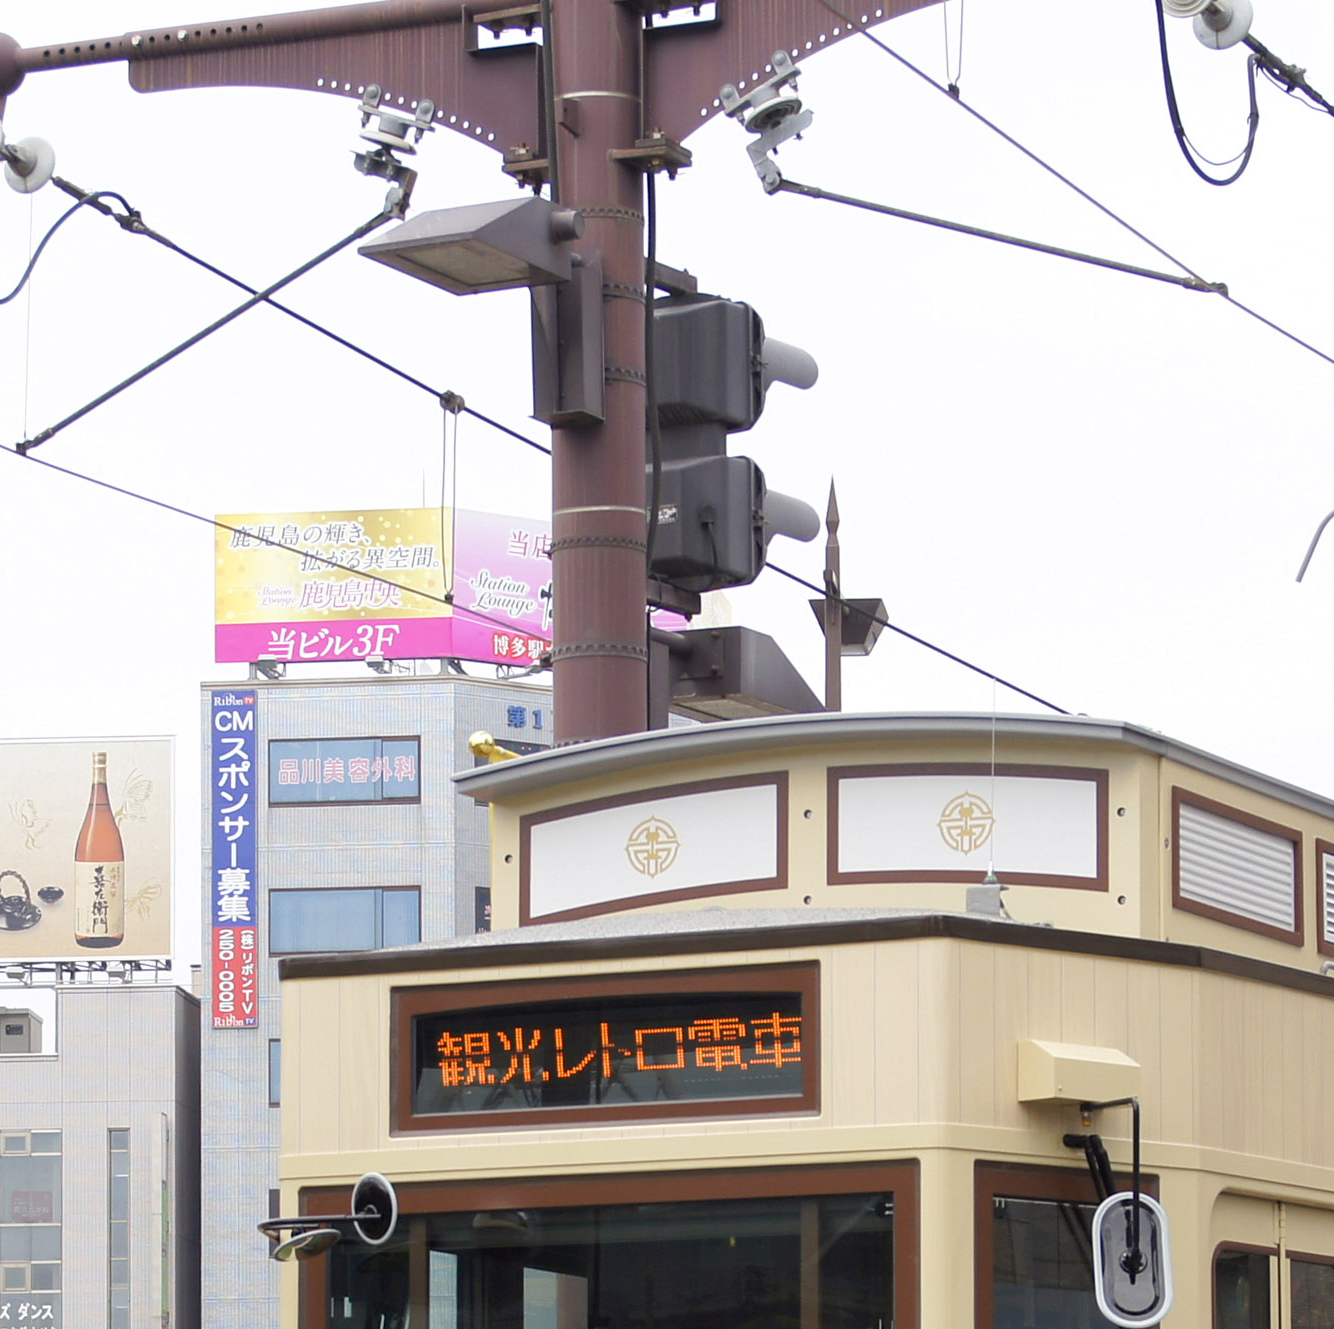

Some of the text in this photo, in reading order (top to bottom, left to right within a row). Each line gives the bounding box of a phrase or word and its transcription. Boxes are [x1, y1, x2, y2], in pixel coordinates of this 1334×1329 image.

[231, 523, 372, 549] 鹿児島の輝き、
[299, 579, 400, 609] 鹿児島中央
[470, 572, 528, 594] Station
[472, 593, 535, 616] Lounge
[267, 624, 400, 660] 当ビル3F
[494, 634, 552, 659] 博多駅
[214, 693, 244, 706] Ribbon
[278, 756, 416, 785] 品川美容外科
[218, 929, 235, 1013] 250-0005
[214, 1014, 243, 1027] Ribbon
[437, 1012, 803, 1087] 観光レトロ電車
[18, 1303, 54, 1321] ダンス
